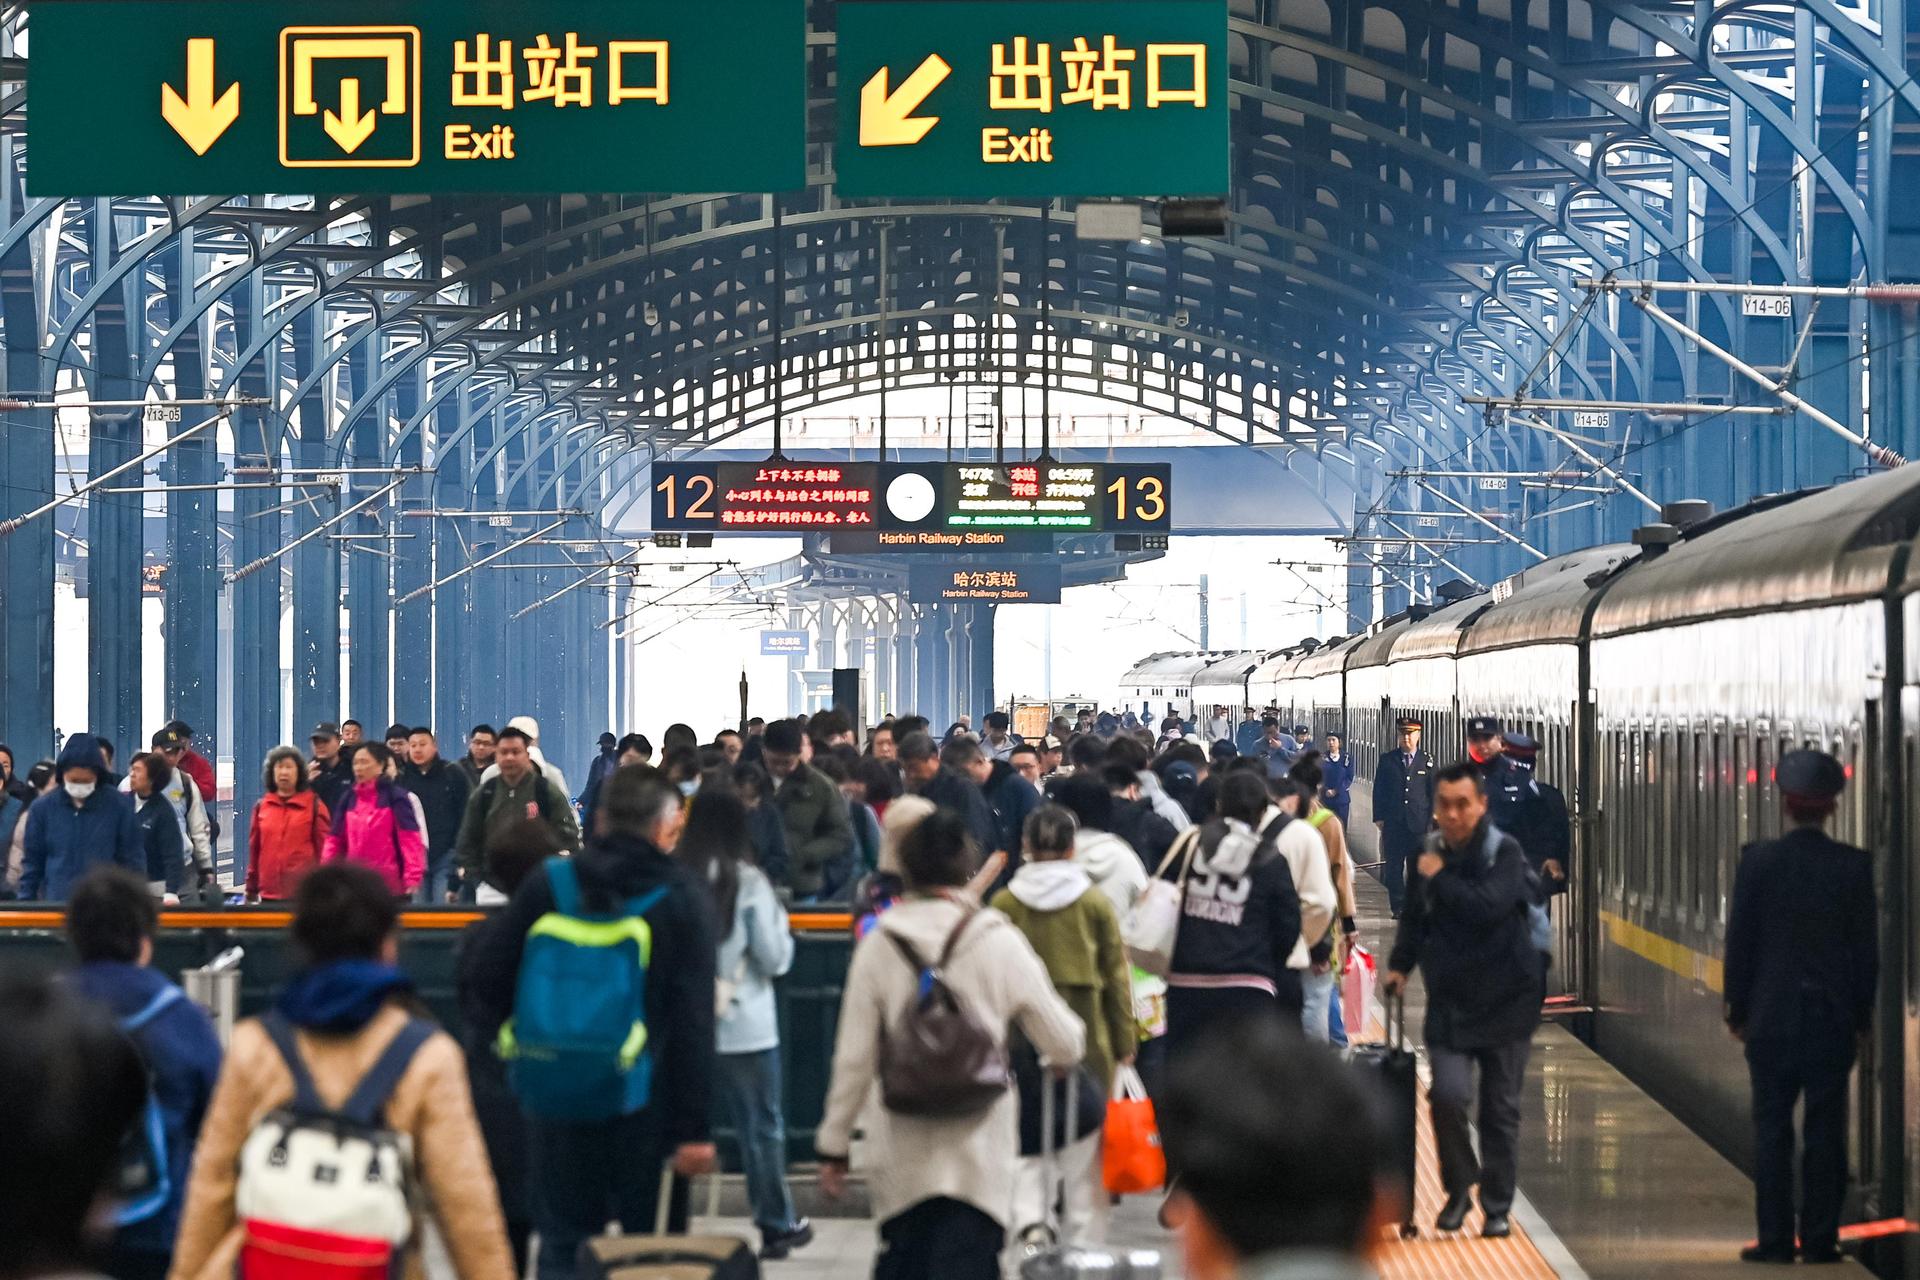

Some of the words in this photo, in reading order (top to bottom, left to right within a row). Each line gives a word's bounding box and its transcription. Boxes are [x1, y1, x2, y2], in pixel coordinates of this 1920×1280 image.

[451, 33, 669, 110] 出站口
[989, 35, 1207, 113] 出站口
[444, 124, 515, 160] Exit
[982, 127, 1053, 163] Exit
[1744, 298, 1790, 315] Y14-06
[147, 409, 180, 421] Y13-05
[1575, 415, 1609, 426] Y14-05
[1010, 467, 1037, 482] 本站
[656, 474, 716, 519] 12
[1011, 482, 1038, 496] 开往
[1108, 476, 1165, 520] 13
[879, 532, 917, 544] Harbin
[918, 532, 962, 546] Railway
[964, 532, 1004, 544] Station
[954, 571, 1017, 587] 哈尔滨站
[942, 589, 968, 598] Harbin
[969, 589, 999, 600] Railway
[1001, 589, 1029, 599] Station
